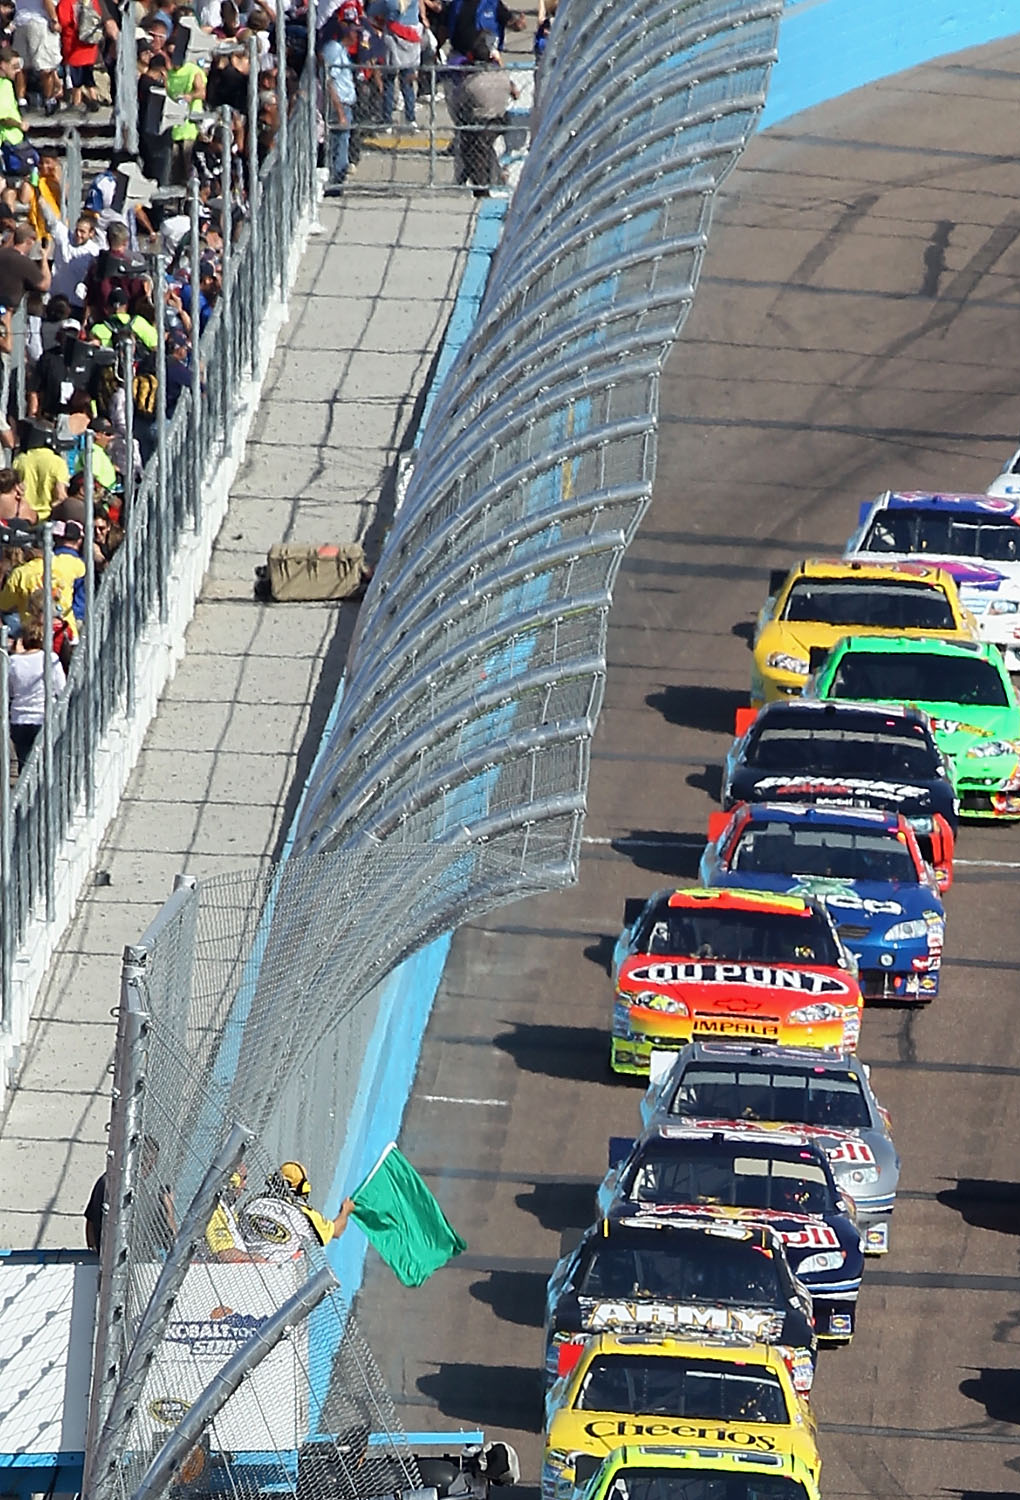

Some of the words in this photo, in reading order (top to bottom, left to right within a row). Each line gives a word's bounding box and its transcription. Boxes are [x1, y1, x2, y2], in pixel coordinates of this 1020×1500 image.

[714, 964, 832, 995] PONT
[692, 1020, 779, 1035] IMPALA
[165, 1323, 231, 1340] KOBALT
[232, 1327, 258, 1338] TOO
[588, 1302, 777, 1335] ARMY
[584, 1420, 777, 1451] Cheerios
